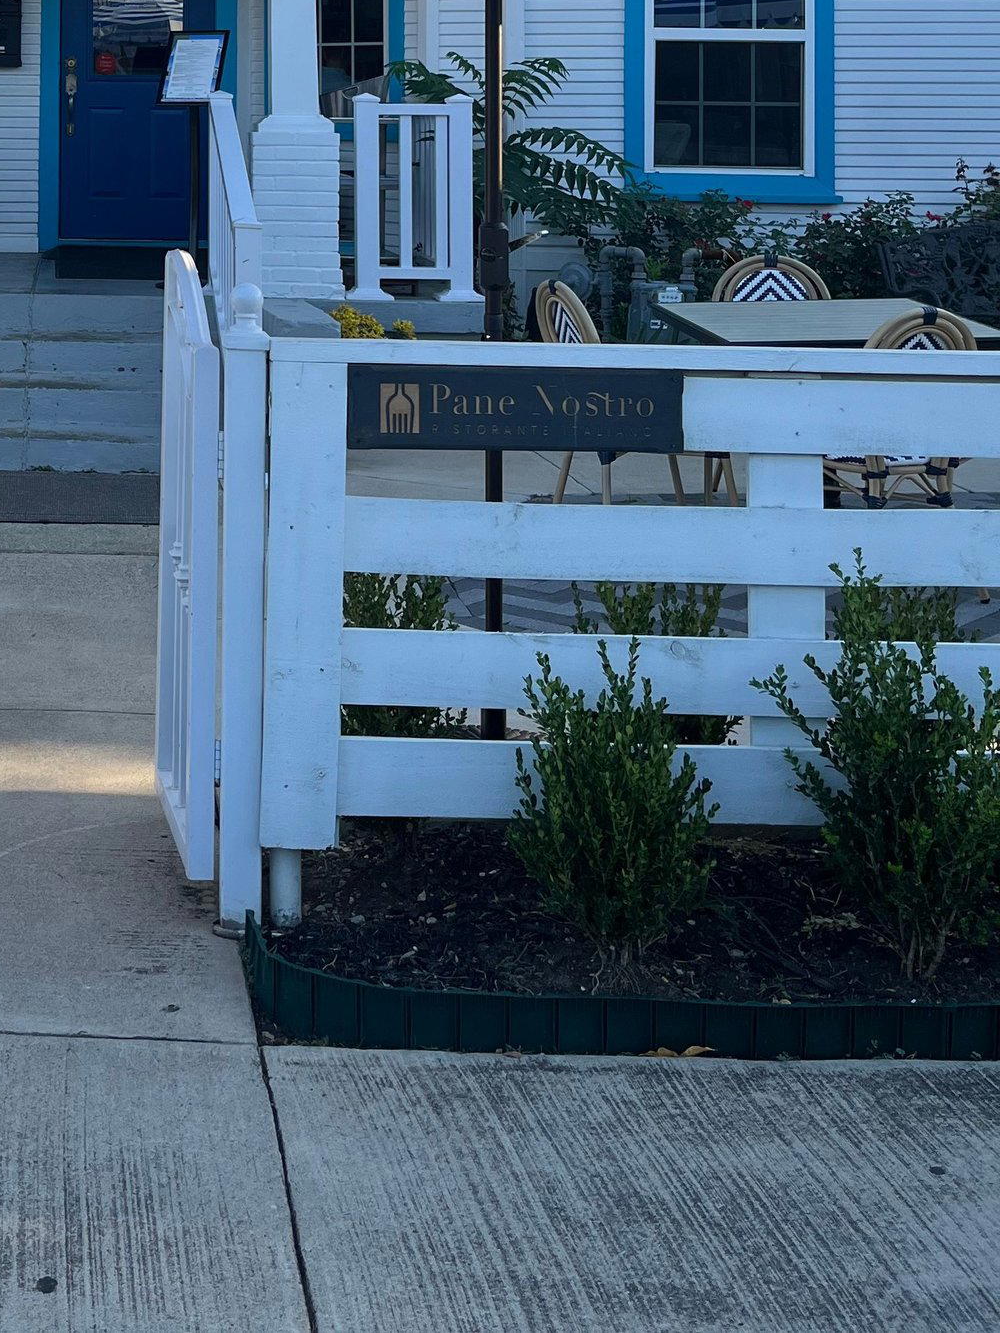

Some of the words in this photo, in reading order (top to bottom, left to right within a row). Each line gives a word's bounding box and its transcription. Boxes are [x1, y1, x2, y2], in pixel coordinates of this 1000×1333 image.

[429, 383, 515, 416] Pane
[532, 385, 655, 418] Nostro
[432, 424, 549, 436] RSTORANTE
